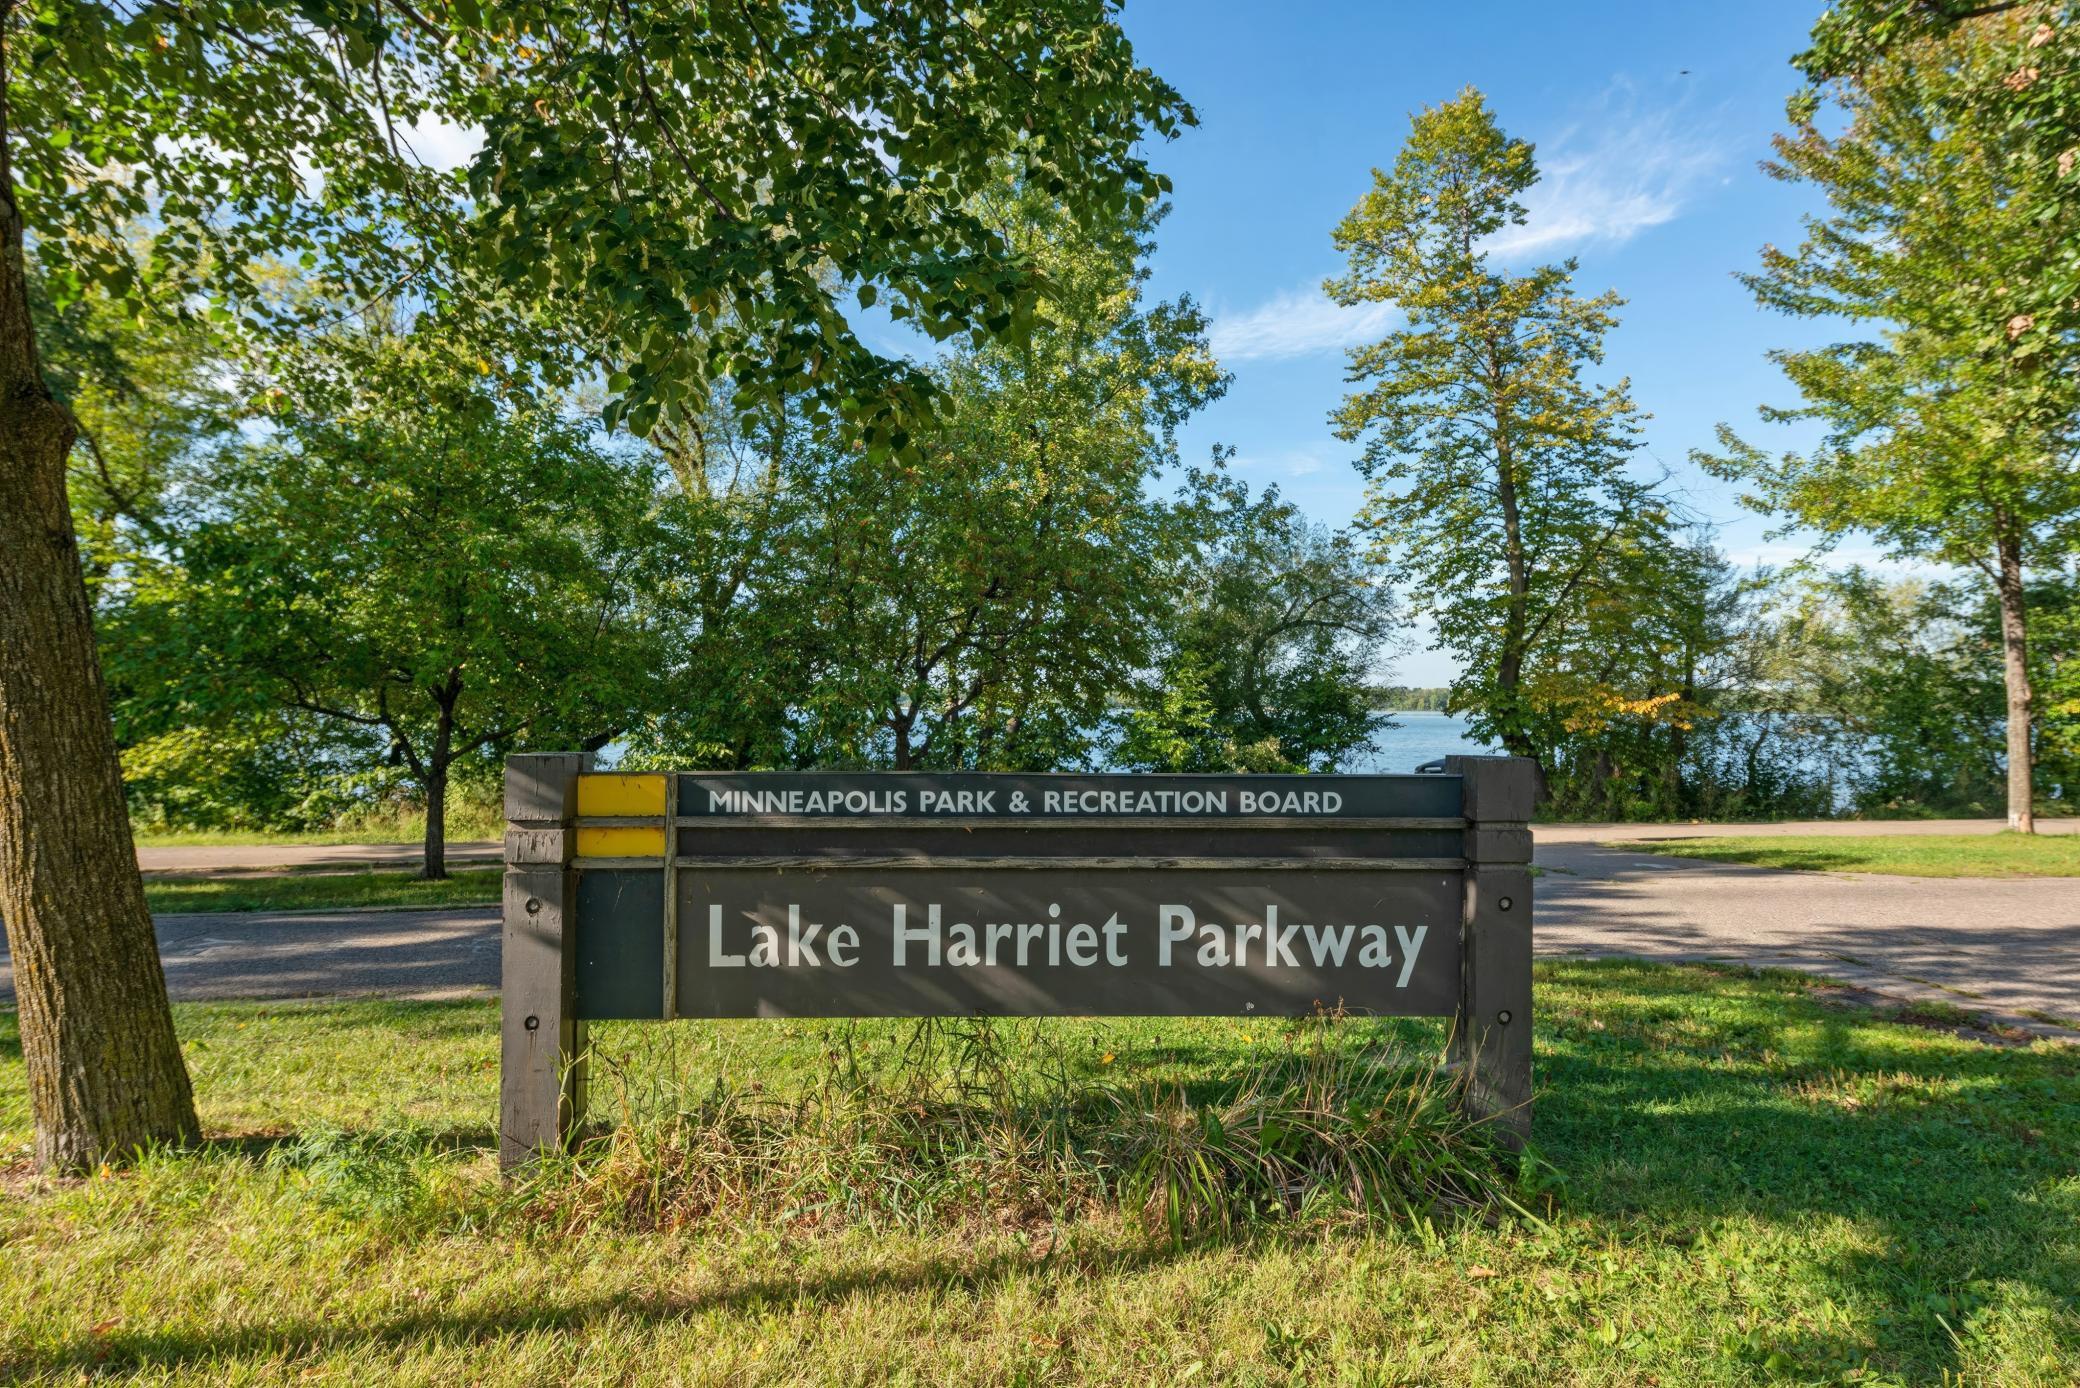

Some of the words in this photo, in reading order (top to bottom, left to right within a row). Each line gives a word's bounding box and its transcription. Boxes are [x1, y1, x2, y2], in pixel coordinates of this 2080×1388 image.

[709, 790, 907, 813] MINNEAPOLIS
[919, 791, 995, 813] PARK
[1008, 791, 1030, 813] &
[1044, 790, 1227, 813] RECREATION
[1240, 791, 1342, 813] BOARD
[709, 904, 860, 968] Lake
[893, 903, 1128, 968] Harriet
[1159, 904, 1428, 988] Parkway
